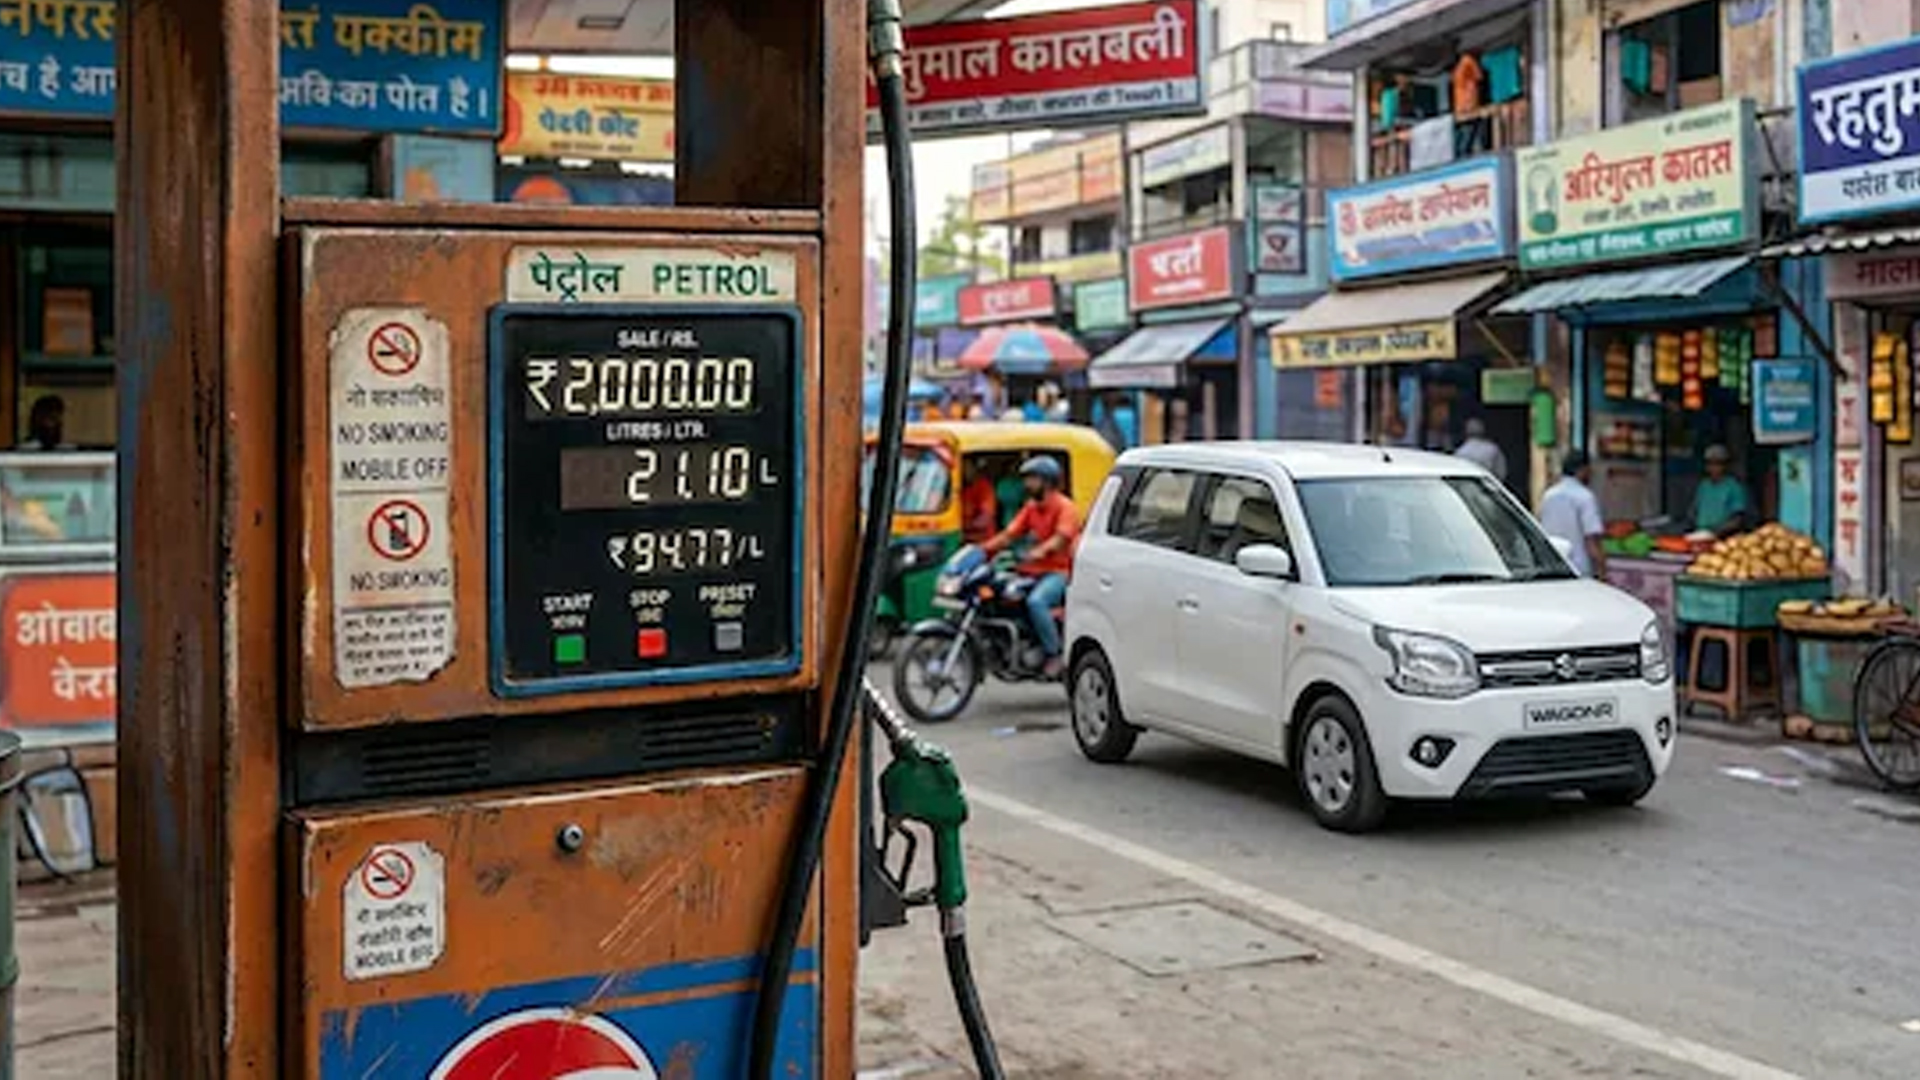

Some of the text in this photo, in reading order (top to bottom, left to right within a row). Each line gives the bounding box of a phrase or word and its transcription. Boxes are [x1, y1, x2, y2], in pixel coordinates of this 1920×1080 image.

[1010, 6, 1186, 72] कालबली
[529, 251, 779, 301] पेट्रोल PETROL
[337, 422, 448, 444] NO SMOKING
[341, 457, 448, 480] MOBILE OFF
[760, 458, 778, 484] L
[350, 573, 374, 591] NO
[699, 584, 756, 602] PRESET
[543, 593, 593, 612] START
[629, 589, 671, 608] STOP
